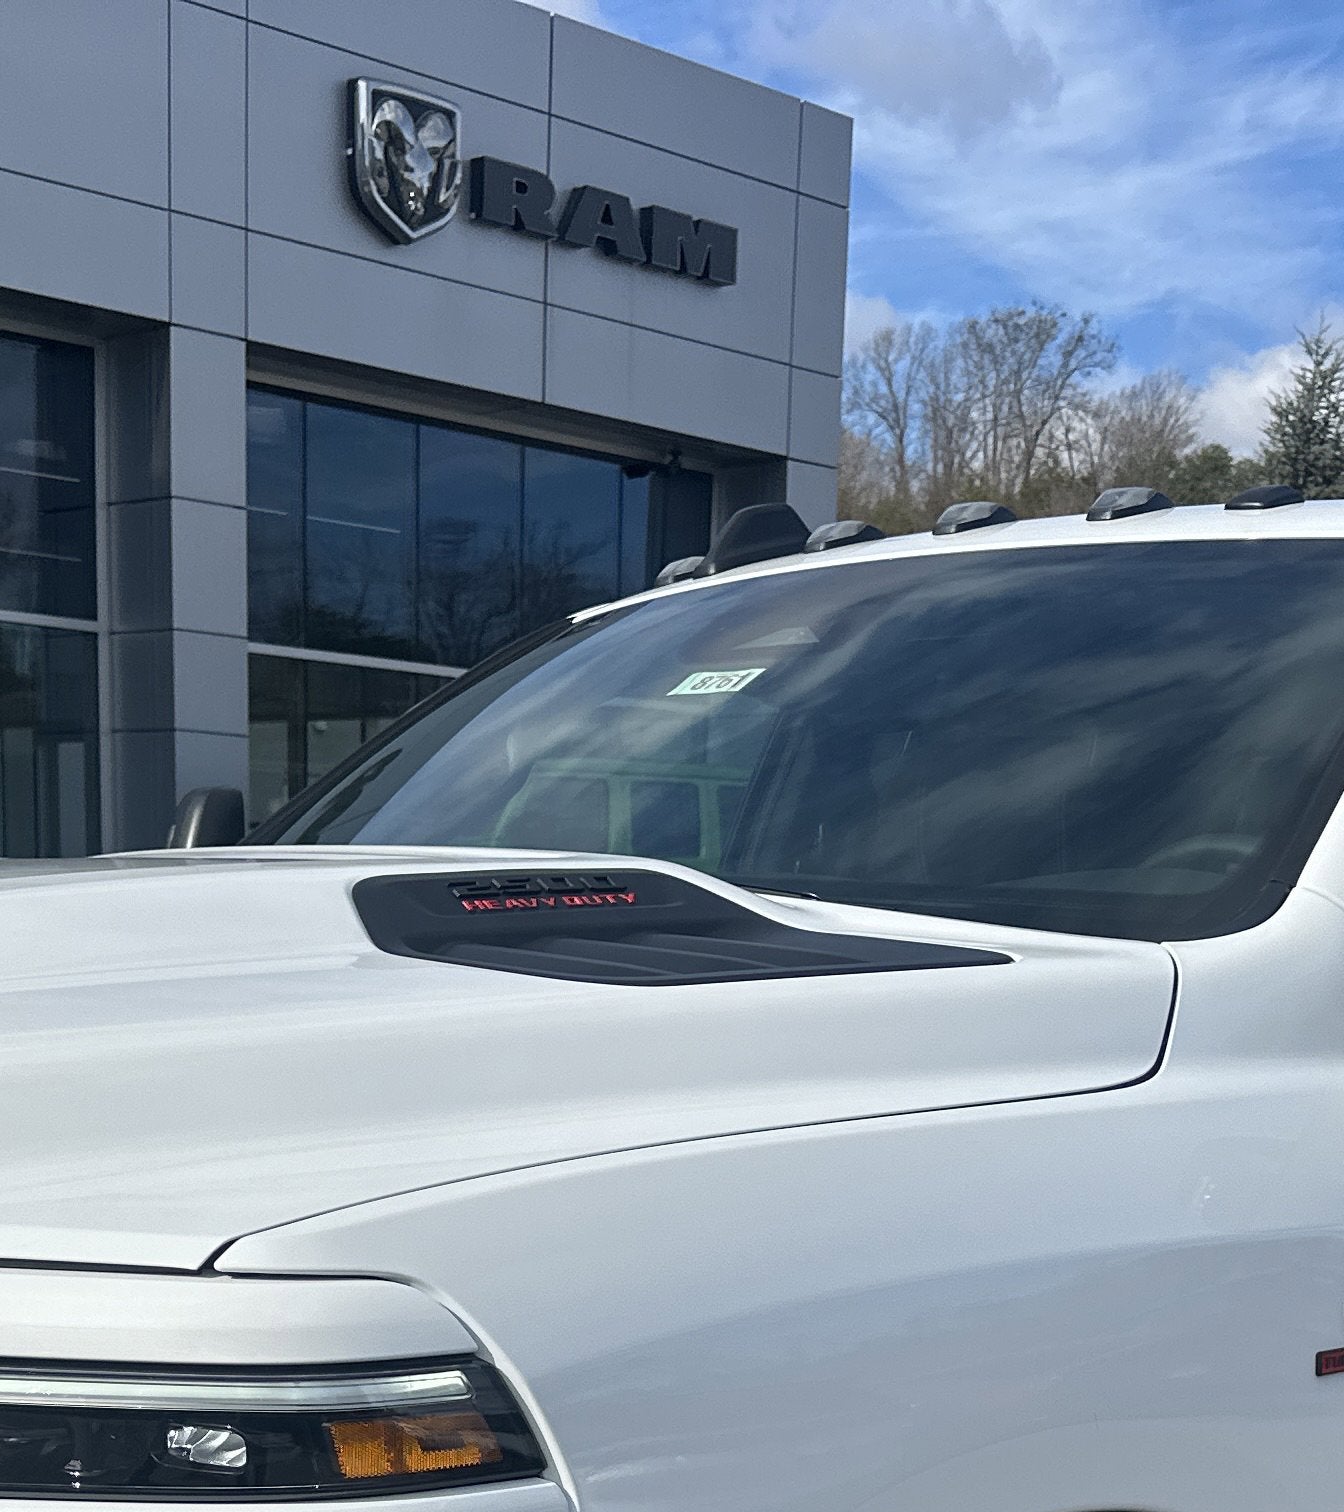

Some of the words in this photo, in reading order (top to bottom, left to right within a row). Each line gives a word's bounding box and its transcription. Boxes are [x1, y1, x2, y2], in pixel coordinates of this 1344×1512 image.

[468, 155, 739, 288] RAM
[690, 671, 754, 691] 8761
[461, 896, 556, 912] HEAVY
[561, 892, 636, 908] DUTY
